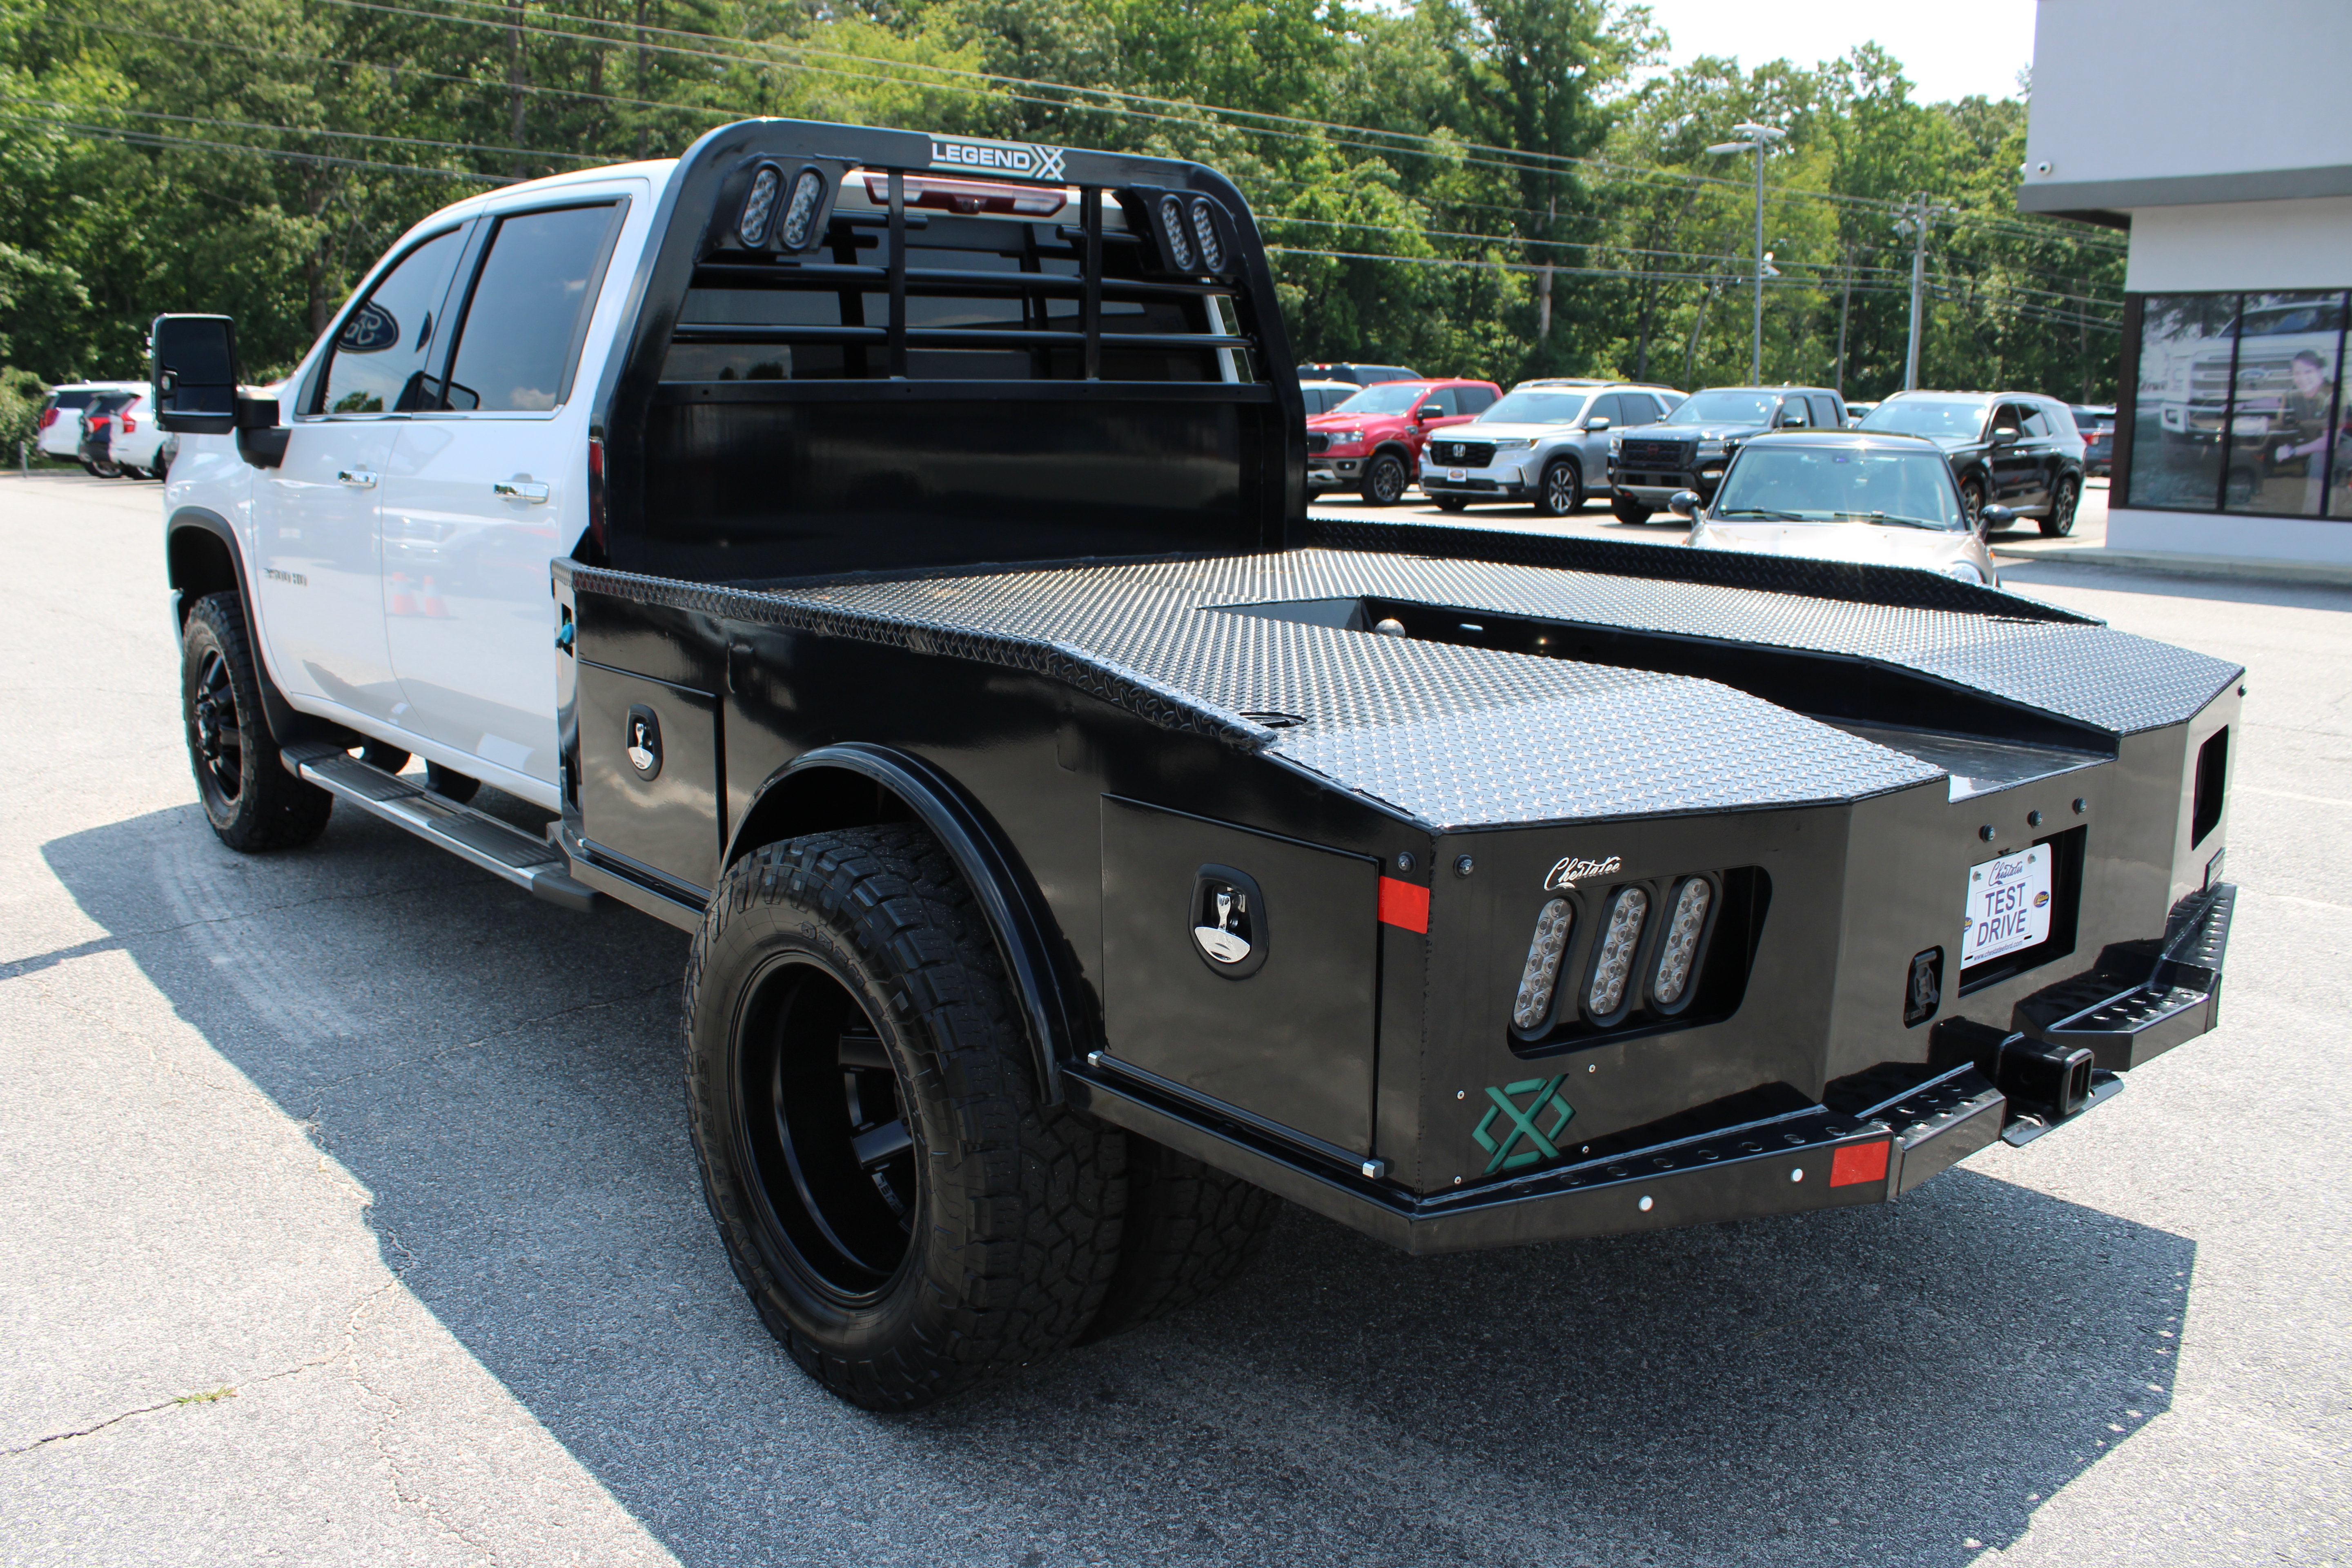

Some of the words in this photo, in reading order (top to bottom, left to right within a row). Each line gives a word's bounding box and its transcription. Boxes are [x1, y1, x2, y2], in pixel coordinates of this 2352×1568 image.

[1544, 856, 1622, 891] Chestatee
[1988, 861, 2022, 886] Chestatee
[1985, 882, 2026, 917] TEST
[1977, 909, 2027, 947] DRIVE
[1973, 940, 2023, 961] www.chestateeford.com
[697, 1055, 727, 1184] TIRES
[718, 1191, 773, 1291] TOYO
